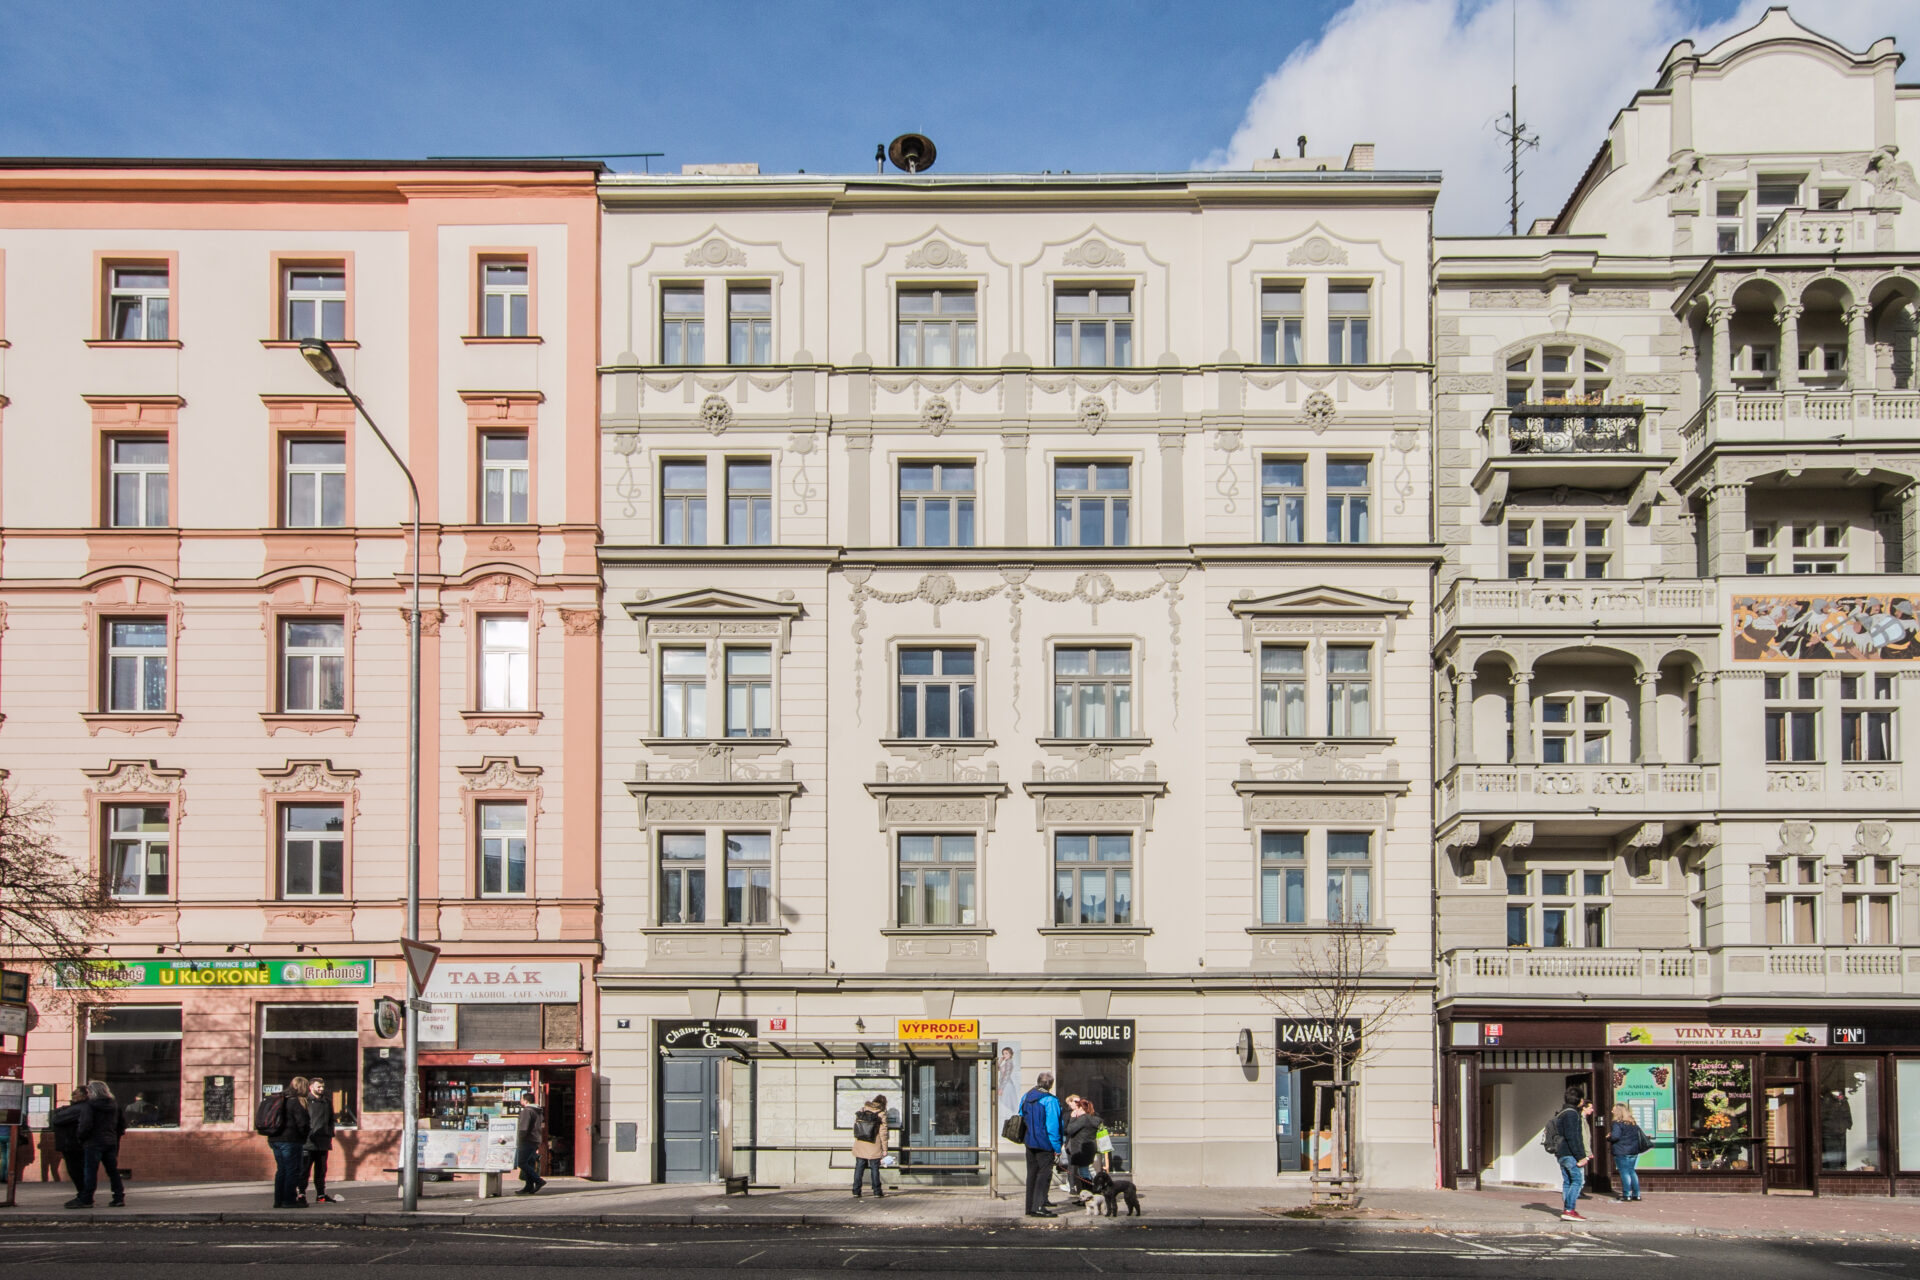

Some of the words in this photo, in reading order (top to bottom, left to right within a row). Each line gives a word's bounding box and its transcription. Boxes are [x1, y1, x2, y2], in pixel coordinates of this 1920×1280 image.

[160, 970, 174, 984] U
[448, 965, 542, 985] TABÁK
[424, 991, 463, 999] CIGARETY
[470, 991, 507, 999] ALKOHOL
[902, 1021, 974, 1033] VÝPRODEJ
[1079, 1025, 1120, 1040] DOUBLE
[1123, 1025, 1131, 1040] B
